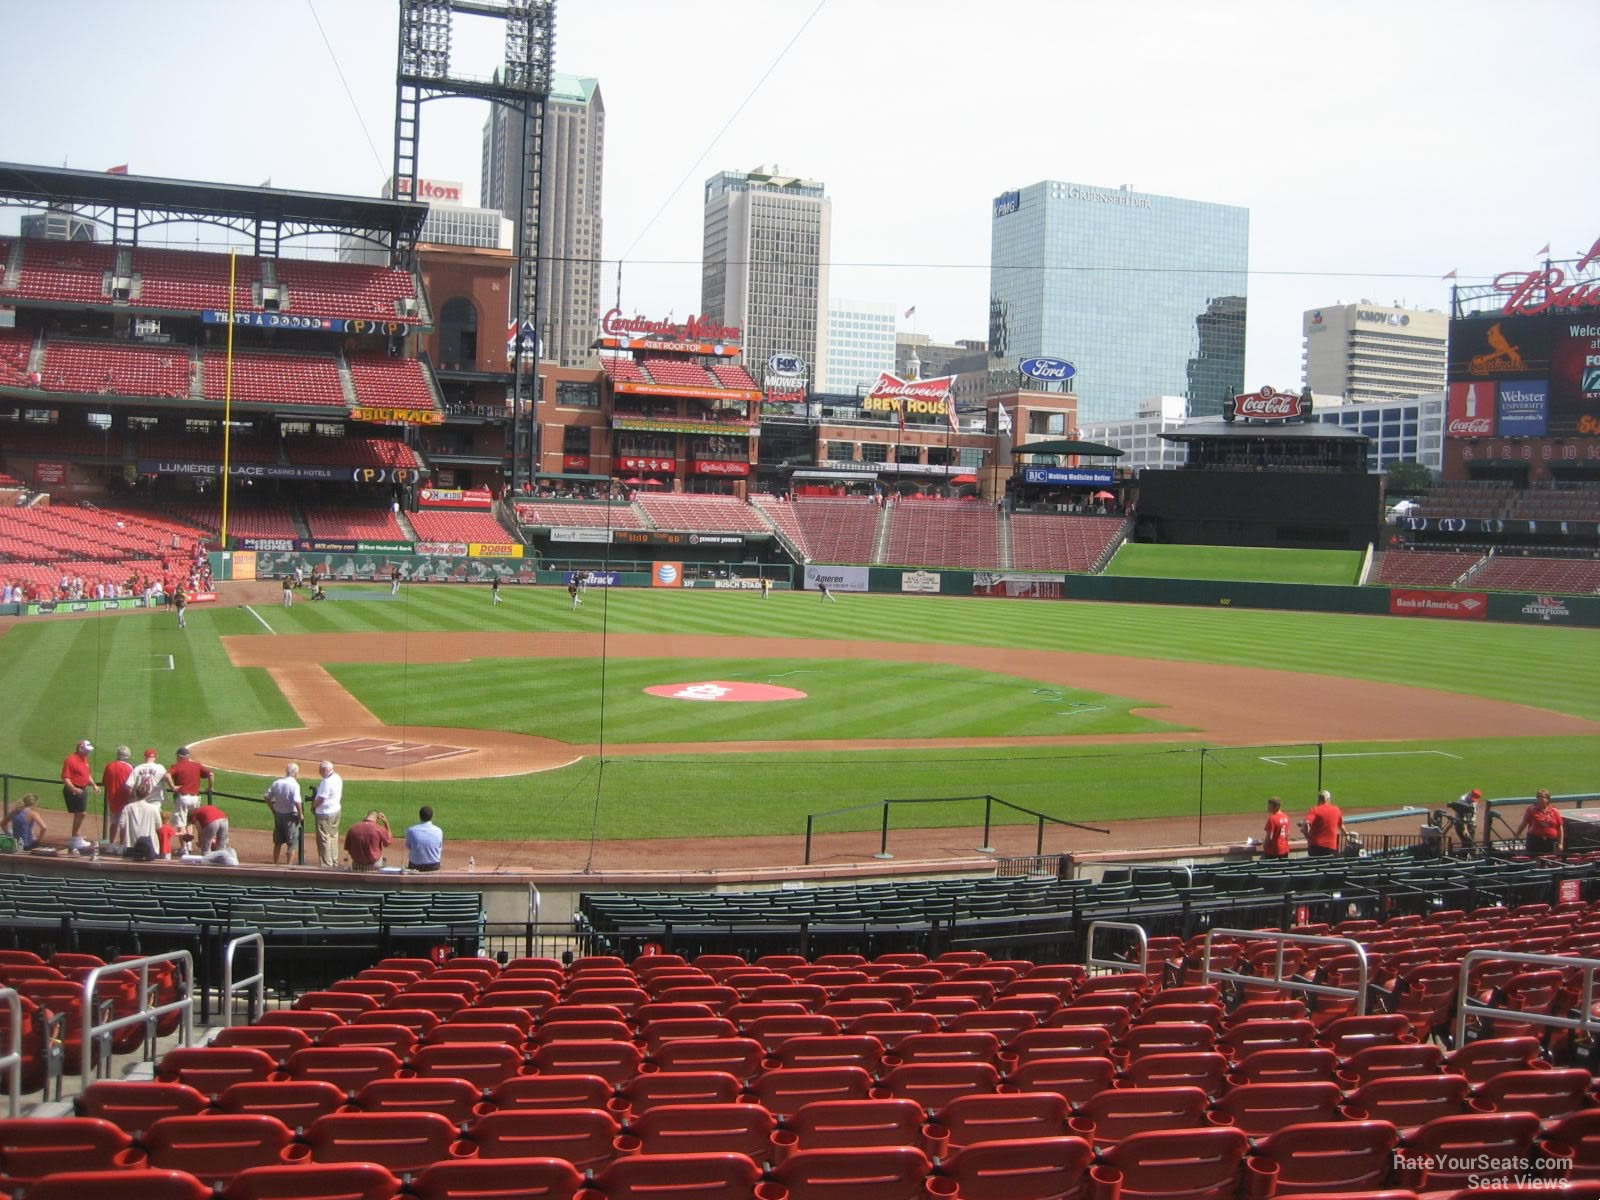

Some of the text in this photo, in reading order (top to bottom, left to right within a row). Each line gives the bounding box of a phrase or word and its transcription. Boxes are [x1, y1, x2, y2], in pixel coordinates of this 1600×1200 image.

[399, 179, 460, 200] Hlton
[994, 200, 1016, 217] KPMG
[256, 315, 263, 325] A
[270, 315, 321, 328] POWER
[1357, 310, 1387, 322] KMOV
[603, 308, 740, 341] Cardinals Nation
[644, 341, 702, 352] AT&T ROOFTOP
[777, 357, 798, 369] FOX
[1032, 360, 1066, 377] Ford
[764, 375, 808, 388] MIDWEST
[872, 379, 949, 398] Budweiser
[1501, 390, 1545, 402] Webster
[863, 397, 900, 410] BREW
[1502, 402, 1545, 410] UNIVERSITY
[362, 408, 432, 423] BIG MAC
[220, 466, 264, 475] PLACE
[1028, 471, 1045, 480] BJC
[1068, 473, 1093, 481] Medicine
[554, 531, 571, 540] Mercy
[715, 580, 773, 589] BUSCH STADIM
[815, 575, 843, 583] Ameren
[1397, 598, 1459, 609] Bank of America
[1521, 607, 1569, 616] CHAMPIONS
